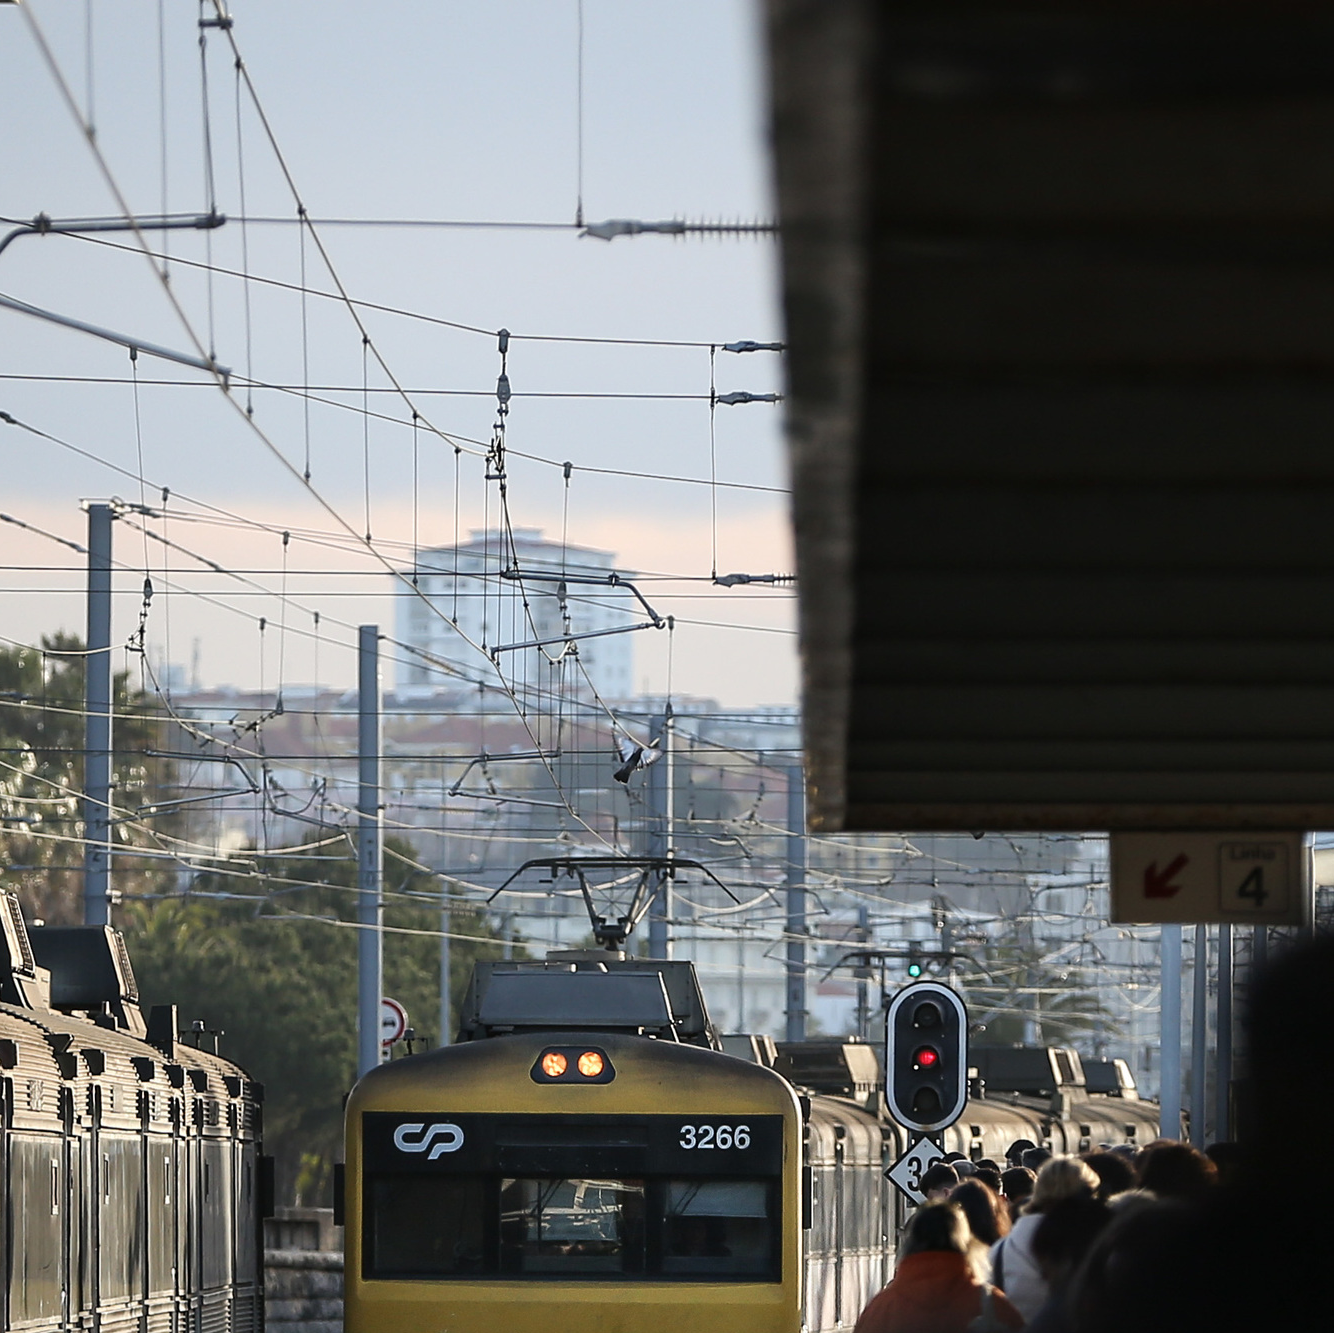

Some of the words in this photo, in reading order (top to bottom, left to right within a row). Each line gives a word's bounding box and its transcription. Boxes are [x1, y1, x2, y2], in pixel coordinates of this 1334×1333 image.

[1229, 843, 1276, 860] Linha
[1237, 865, 1269, 907] 4
[393, 1123, 465, 1161] CP
[679, 1124, 751, 1151] 3266
